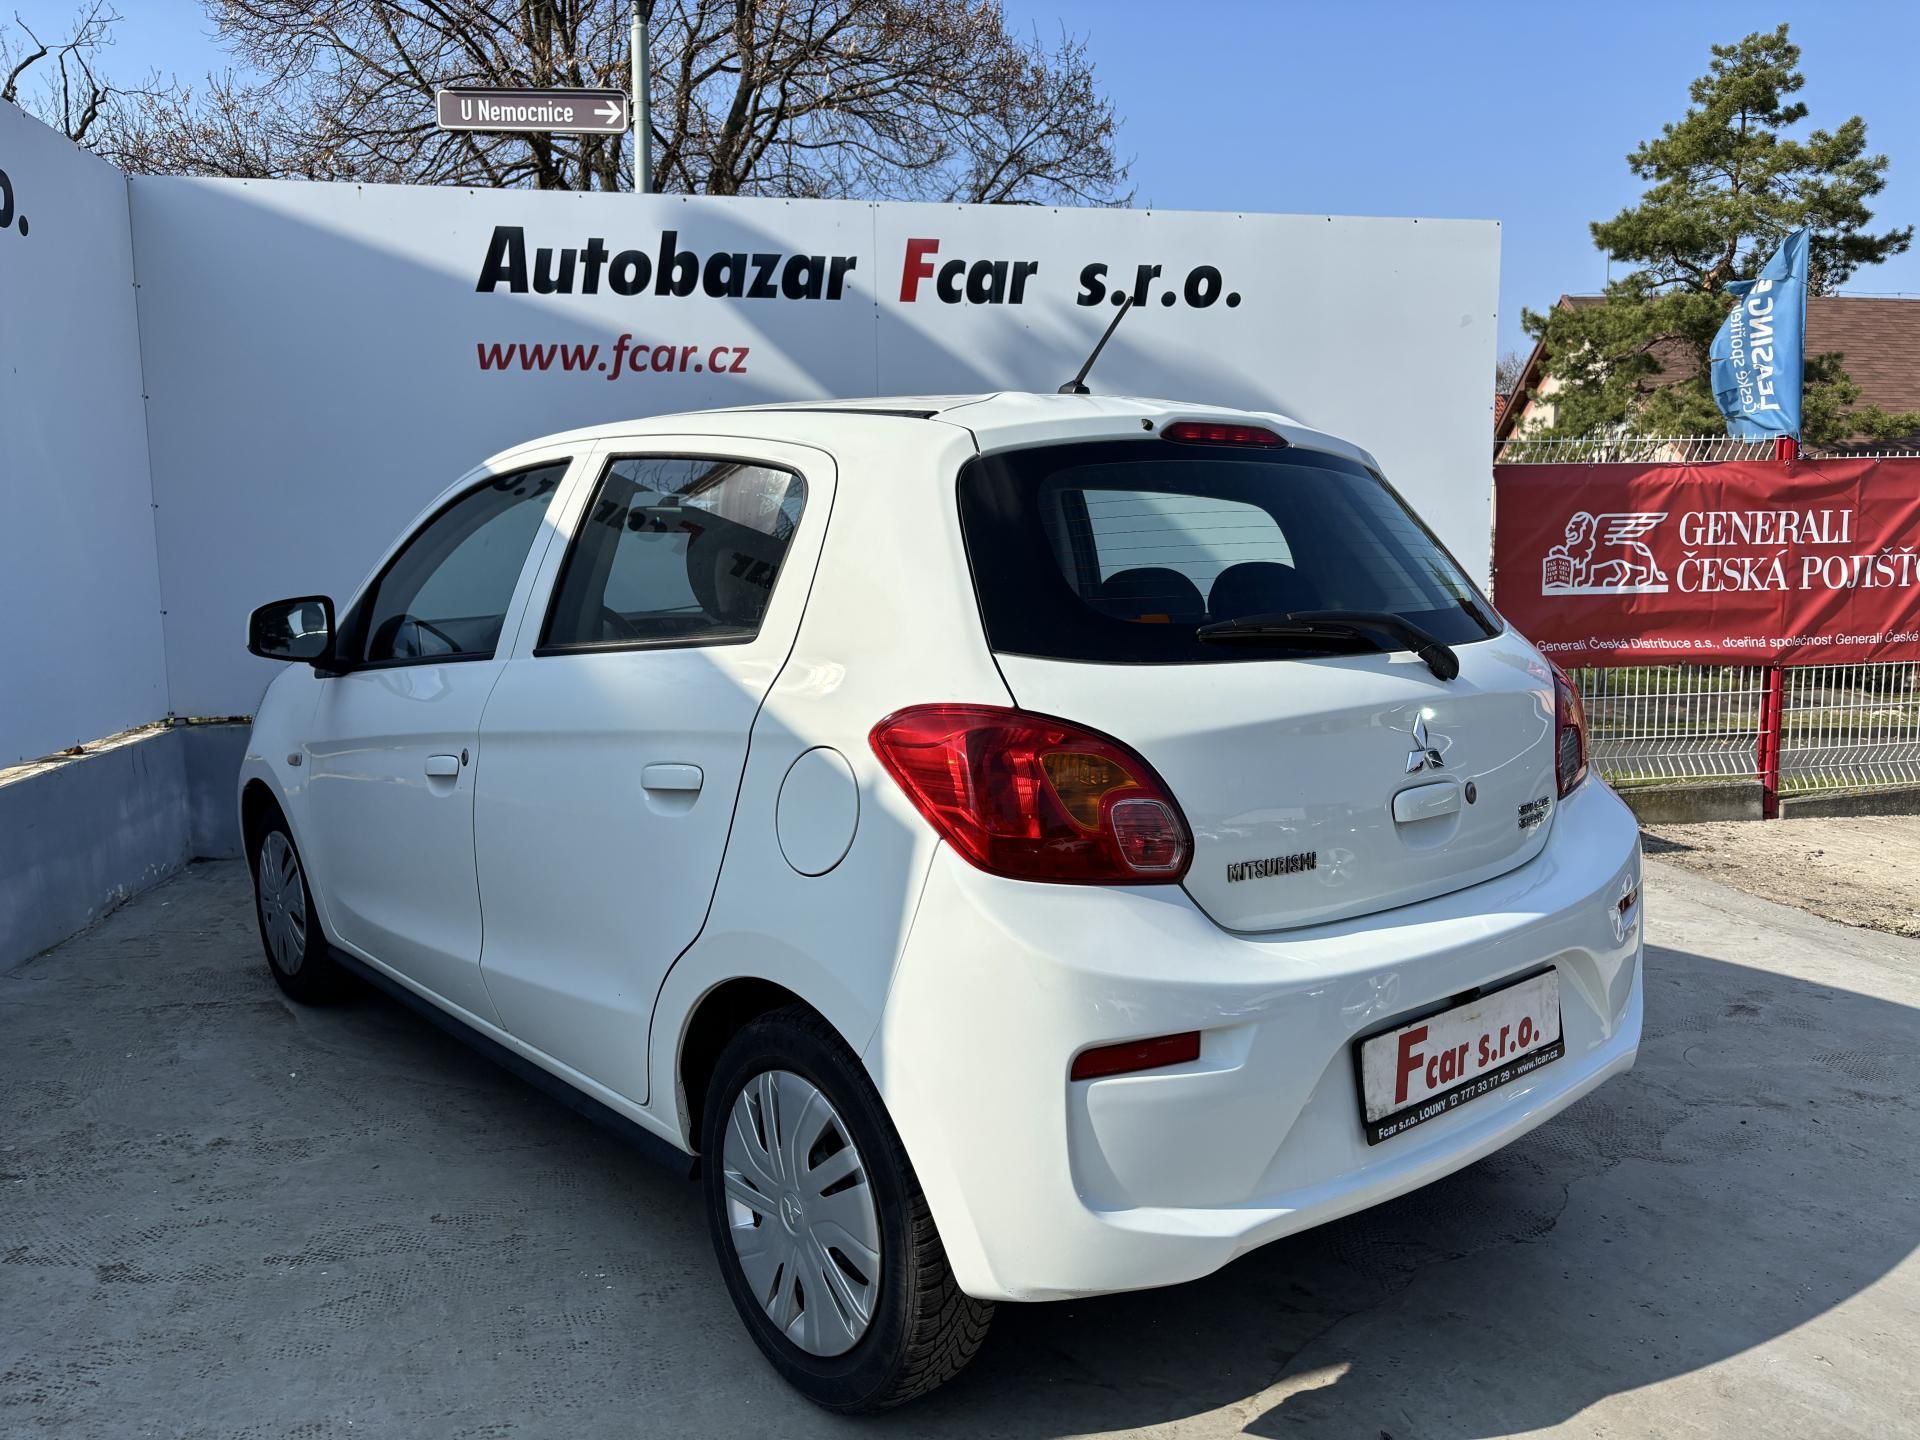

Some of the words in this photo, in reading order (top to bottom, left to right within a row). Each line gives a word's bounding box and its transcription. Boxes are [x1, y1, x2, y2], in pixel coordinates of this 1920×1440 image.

[460, 99, 472, 121] U
[478, 99, 574, 123] Nemocnice
[475, 225, 857, 301] Autobazar
[899, 238, 1038, 305] Fcar
[1076, 262, 1241, 308] s.r.o.
[476, 333, 750, 381] www.fcar.cz
[1679, 509, 1853, 547] GENERALI
[1676, 549, 1790, 593] ČESKÁ
[1799, 546, 1920, 591] POJIŠŤ
[1536, 639, 1587, 653] Generali
[1589, 636, 1629, 650] Česká
[1630, 637, 1691, 650] Distribuce
[1722, 635, 1767, 649] dceřiná
[1769, 633, 1832, 650] společnost
[1835, 632, 1883, 646] Generali
[1885, 629, 1919, 643] České
[1227, 851, 1317, 883] MITSUBISHI
[1395, 1025, 1469, 1105] Fcar
[1478, 1016, 1540, 1068] s.r.o.
[1378, 1124, 1397, 1140] Fcar
[1399, 1116, 1418, 1130] s.r.o.
[1420, 1099, 1446, 1121] LOUNY
[1460, 1085, 1476, 1100] 777
[1477, 1080, 1488, 1093] 33
[1489, 1075, 1499, 1088] 77
[1500, 1070, 1510, 1083] 29
[1517, 1049, 1558, 1075] www.fcar.cz
